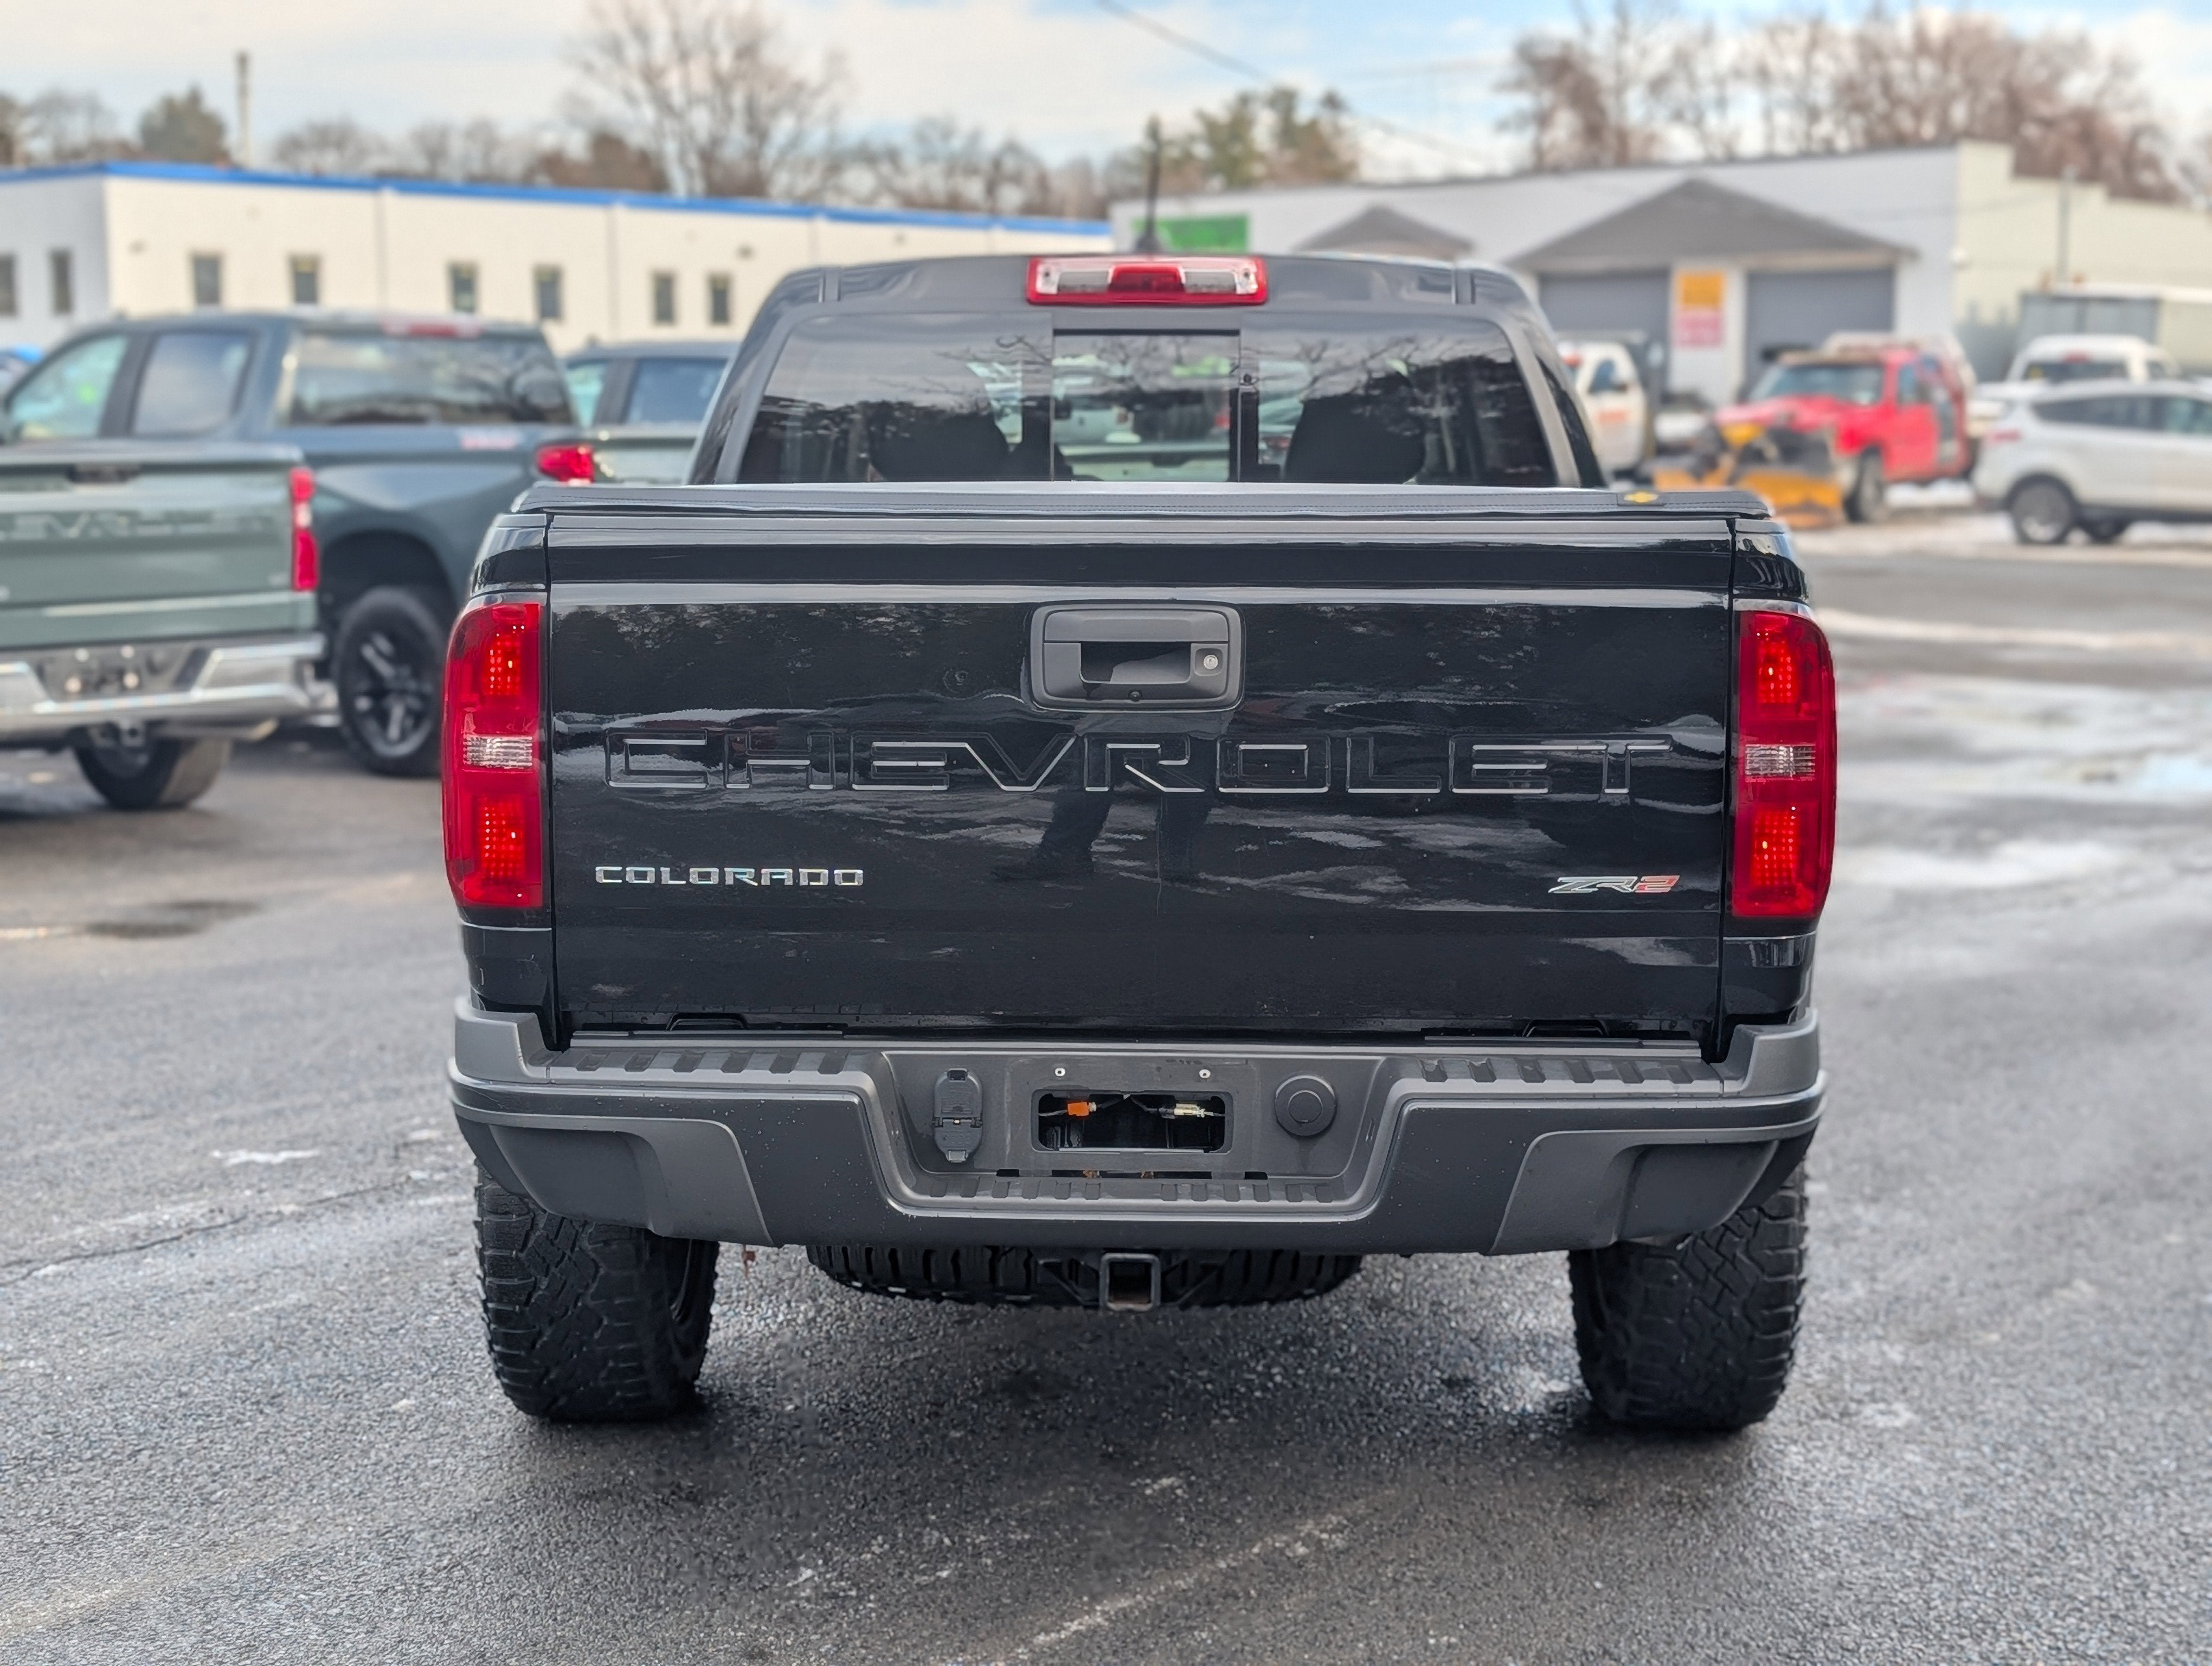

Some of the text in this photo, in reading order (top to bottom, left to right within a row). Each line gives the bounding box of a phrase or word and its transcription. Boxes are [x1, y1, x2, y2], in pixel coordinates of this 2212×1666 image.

[606, 728, 1674, 794] CHEVROLET
[595, 866, 864, 886] COLORADO
[1548, 875, 1680, 893] ZR2
